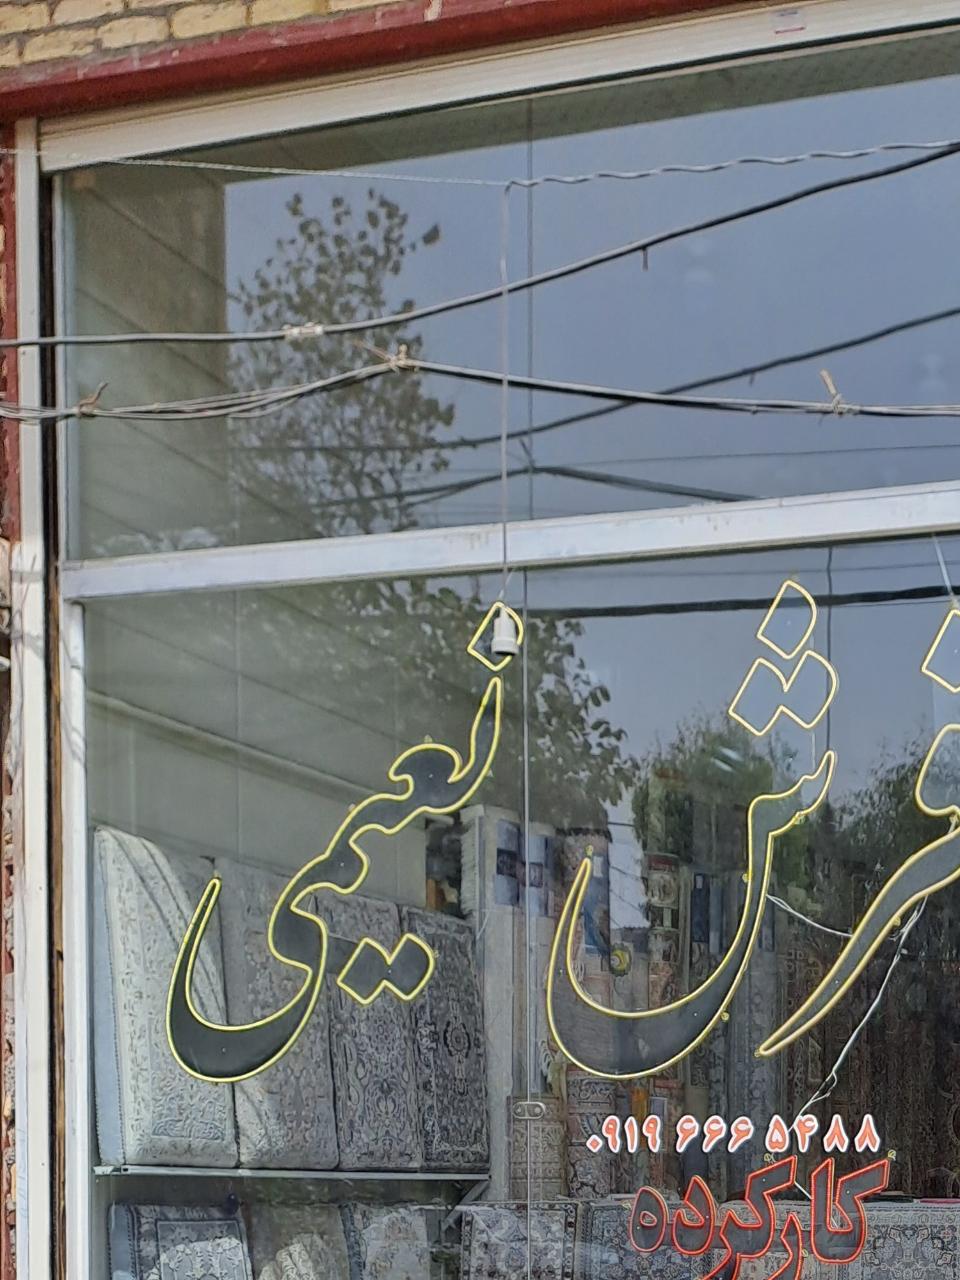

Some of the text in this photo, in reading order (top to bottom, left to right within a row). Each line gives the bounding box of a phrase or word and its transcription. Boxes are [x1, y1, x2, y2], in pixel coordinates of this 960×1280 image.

[166, 600, 525, 1083] نعیمی
[586, 1113, 881, 1153] ۰۹۱۹ ۶۶۶ ۵۴۸۸
